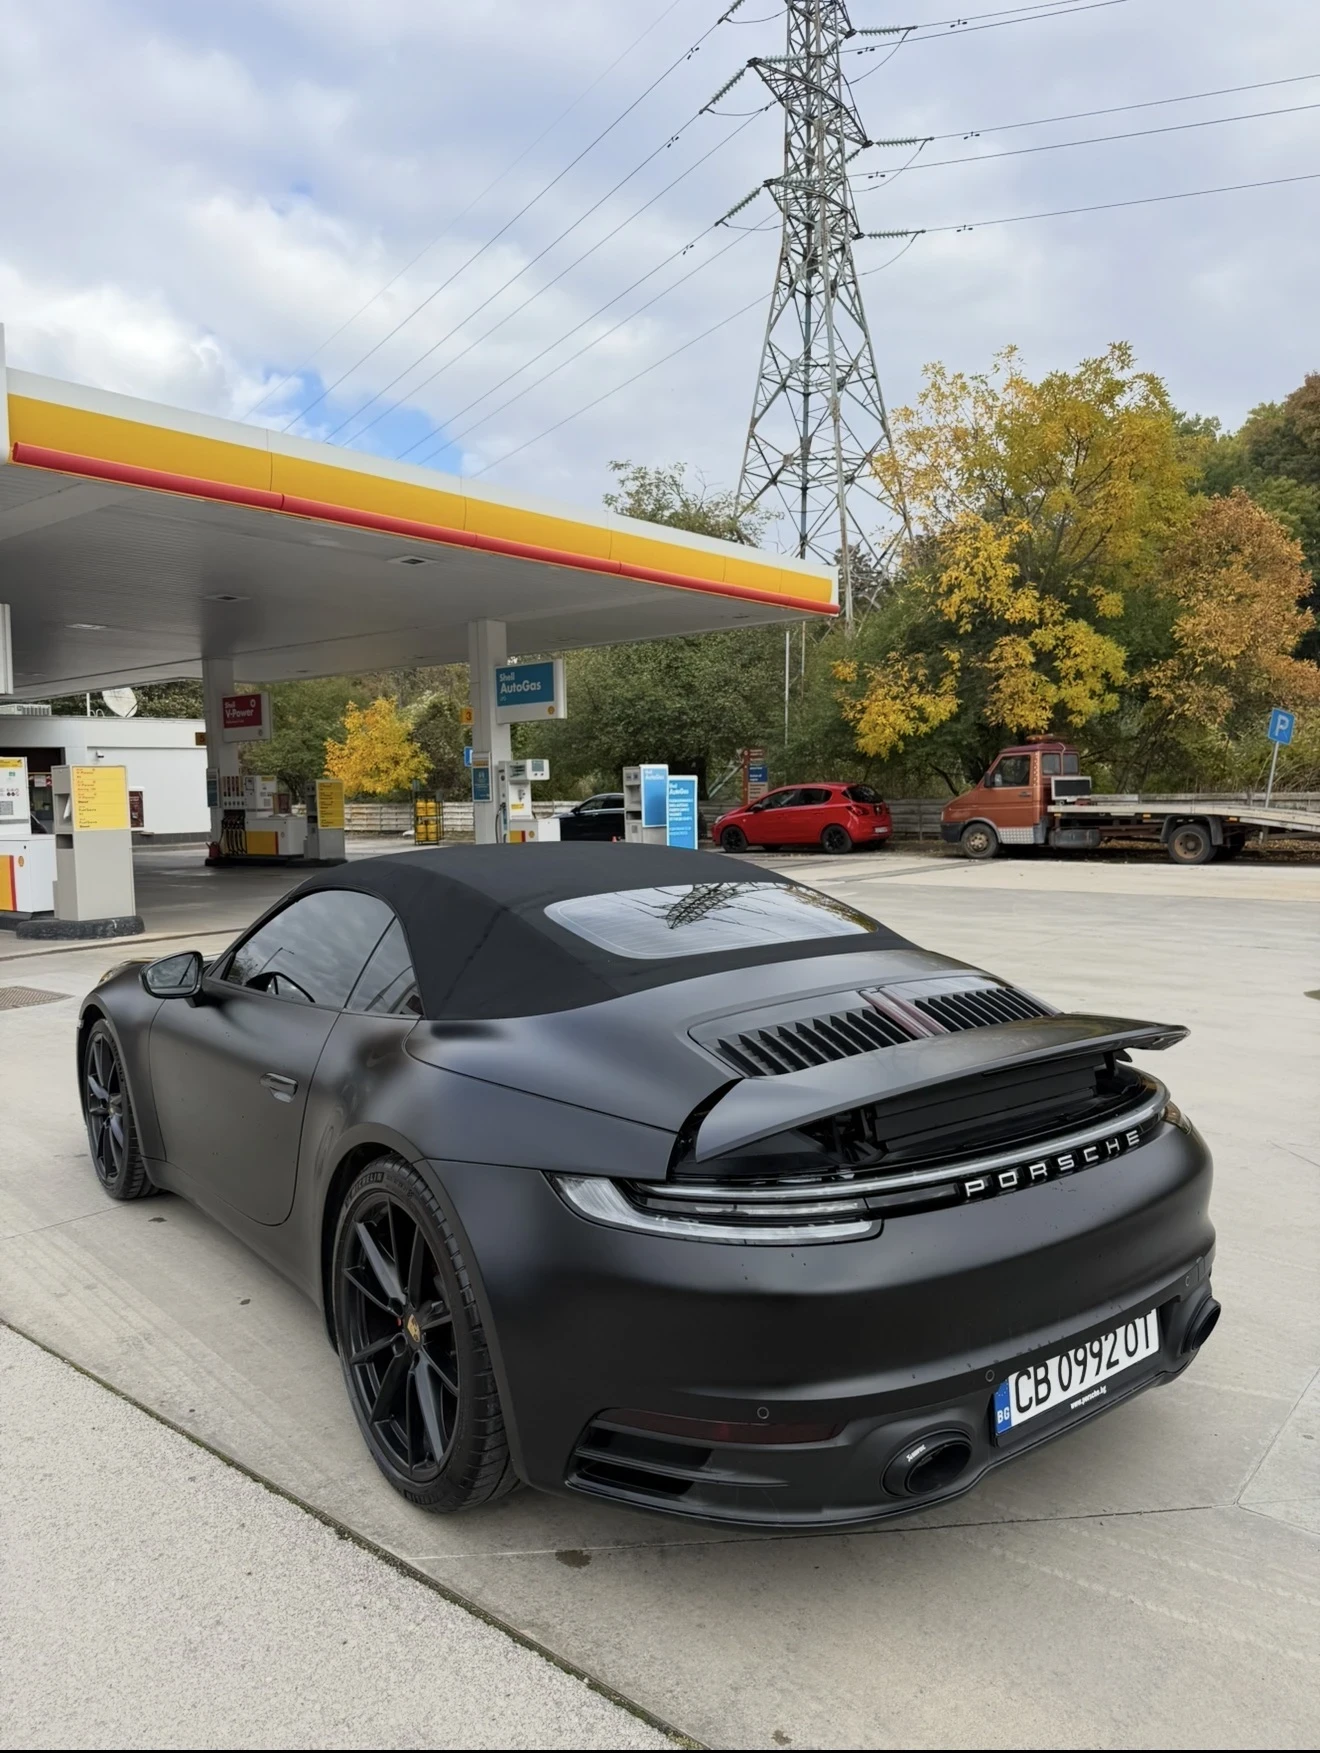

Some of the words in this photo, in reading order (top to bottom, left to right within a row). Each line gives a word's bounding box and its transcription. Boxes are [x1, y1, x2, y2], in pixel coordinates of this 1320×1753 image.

[499, 672, 515, 682] Shell
[500, 679, 542, 694] AutoGas
[225, 708, 254, 719] V-Power
[465, 711, 472, 721] 3
[1275, 714, 1290, 737] P
[199, 734, 206, 743] 5
[964, 1130, 1140, 1196] PORSCHE
[1015, 1361, 1052, 1414] CB
[1058, 1331, 1121, 1392] 0992
[997, 1410, 1011, 1425] BG
